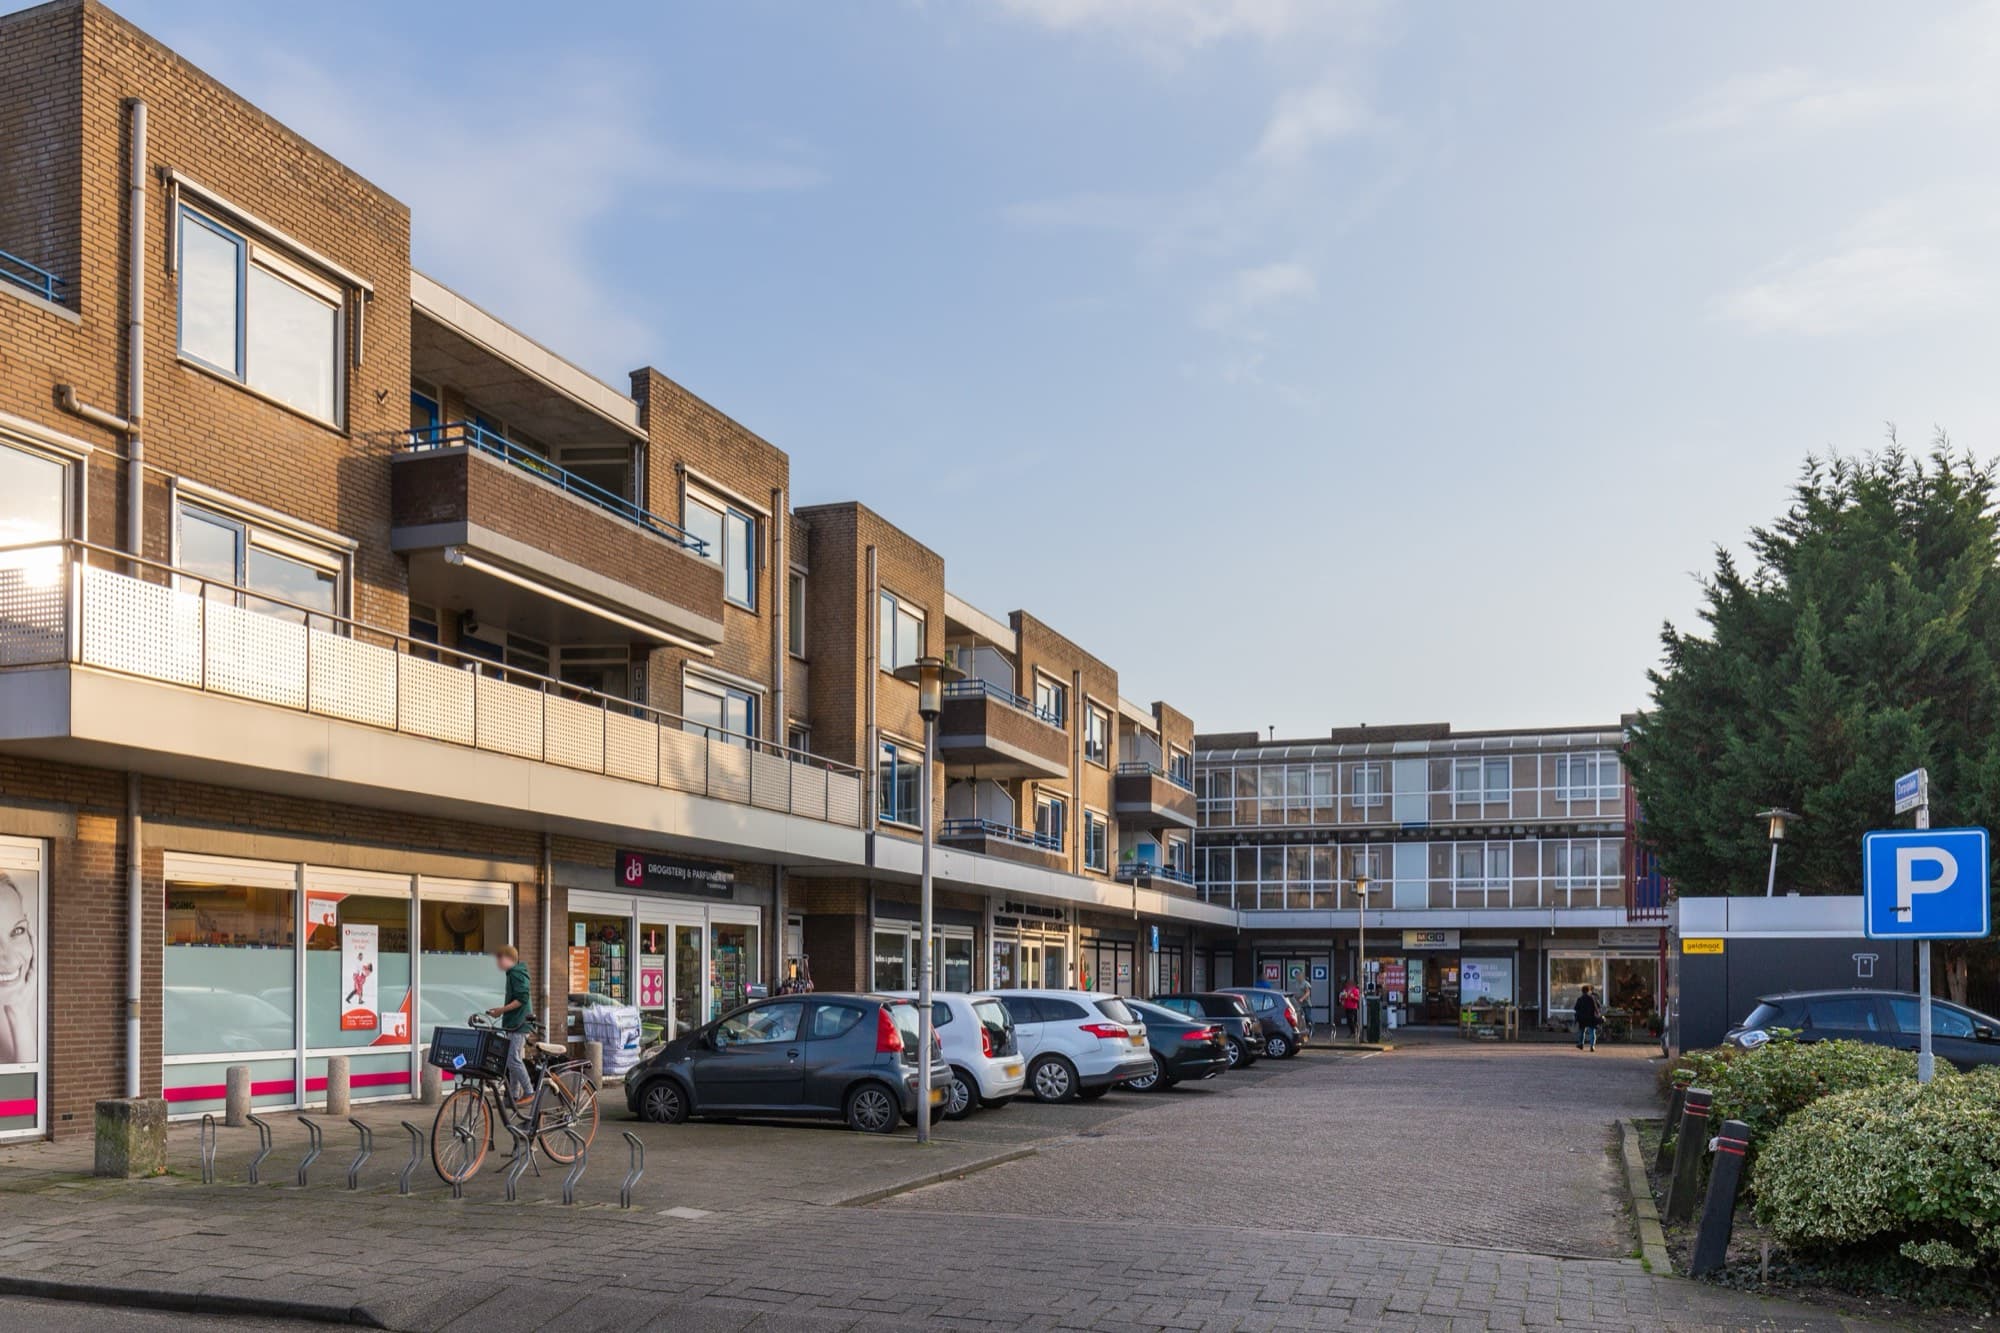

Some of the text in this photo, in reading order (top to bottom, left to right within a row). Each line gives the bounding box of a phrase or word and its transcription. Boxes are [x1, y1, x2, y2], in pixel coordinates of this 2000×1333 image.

[626, 859, 642, 881] da
[648, 864, 686, 880] DROGISTERIJ
[1897, 847, 1958, 923] P
[1266, 967, 1278, 978] M
[1315, 968, 1325, 978] D
